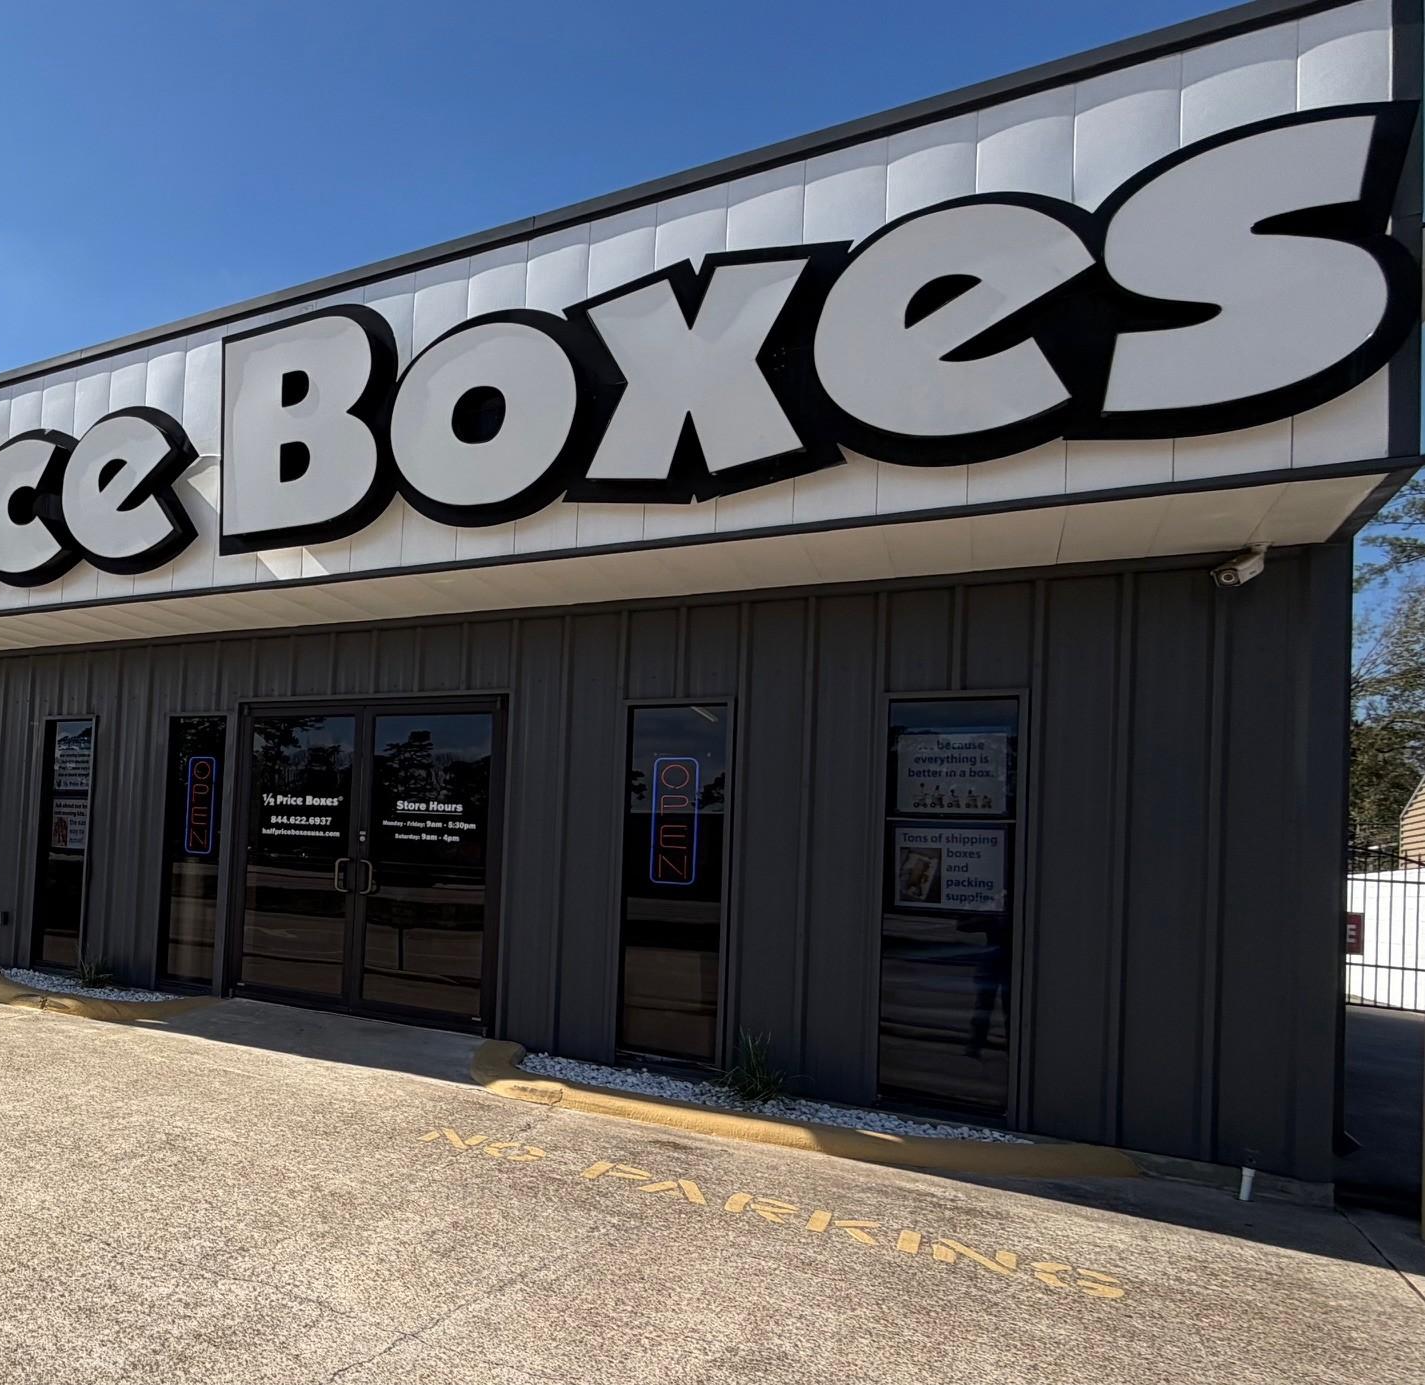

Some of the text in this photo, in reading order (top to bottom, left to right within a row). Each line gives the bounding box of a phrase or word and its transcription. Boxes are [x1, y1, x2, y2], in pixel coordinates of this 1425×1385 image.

[222, 100, 1422, 556] Boxes
[937, 740, 984, 750] because
[914, 754, 989, 766] everything is
[908, 768, 942, 777] better
[945, 768, 956, 777] in
[969, 768, 994, 778] box.
[188, 760, 212, 848] OPEN
[276, 794, 303, 805] Price
[396, 800, 463, 812] Store Hours
[270, 815, 332, 825] 844.622.6937
[426, 820, 442, 828] 9am
[448, 821, 476, 830] 5:30pm
[657, 763, 690, 880] OPEN
[262, 827, 340, 837] halfpriceboxesusa.com
[443, 834, 460, 842] 4pm
[902, 832, 998, 847] Tons of shipping
[946, 848, 981, 859] boxes
[946, 862, 969, 873] and
[945, 877, 994, 891] packing
[418, 1127, 1126, 1298] NO PARKING
